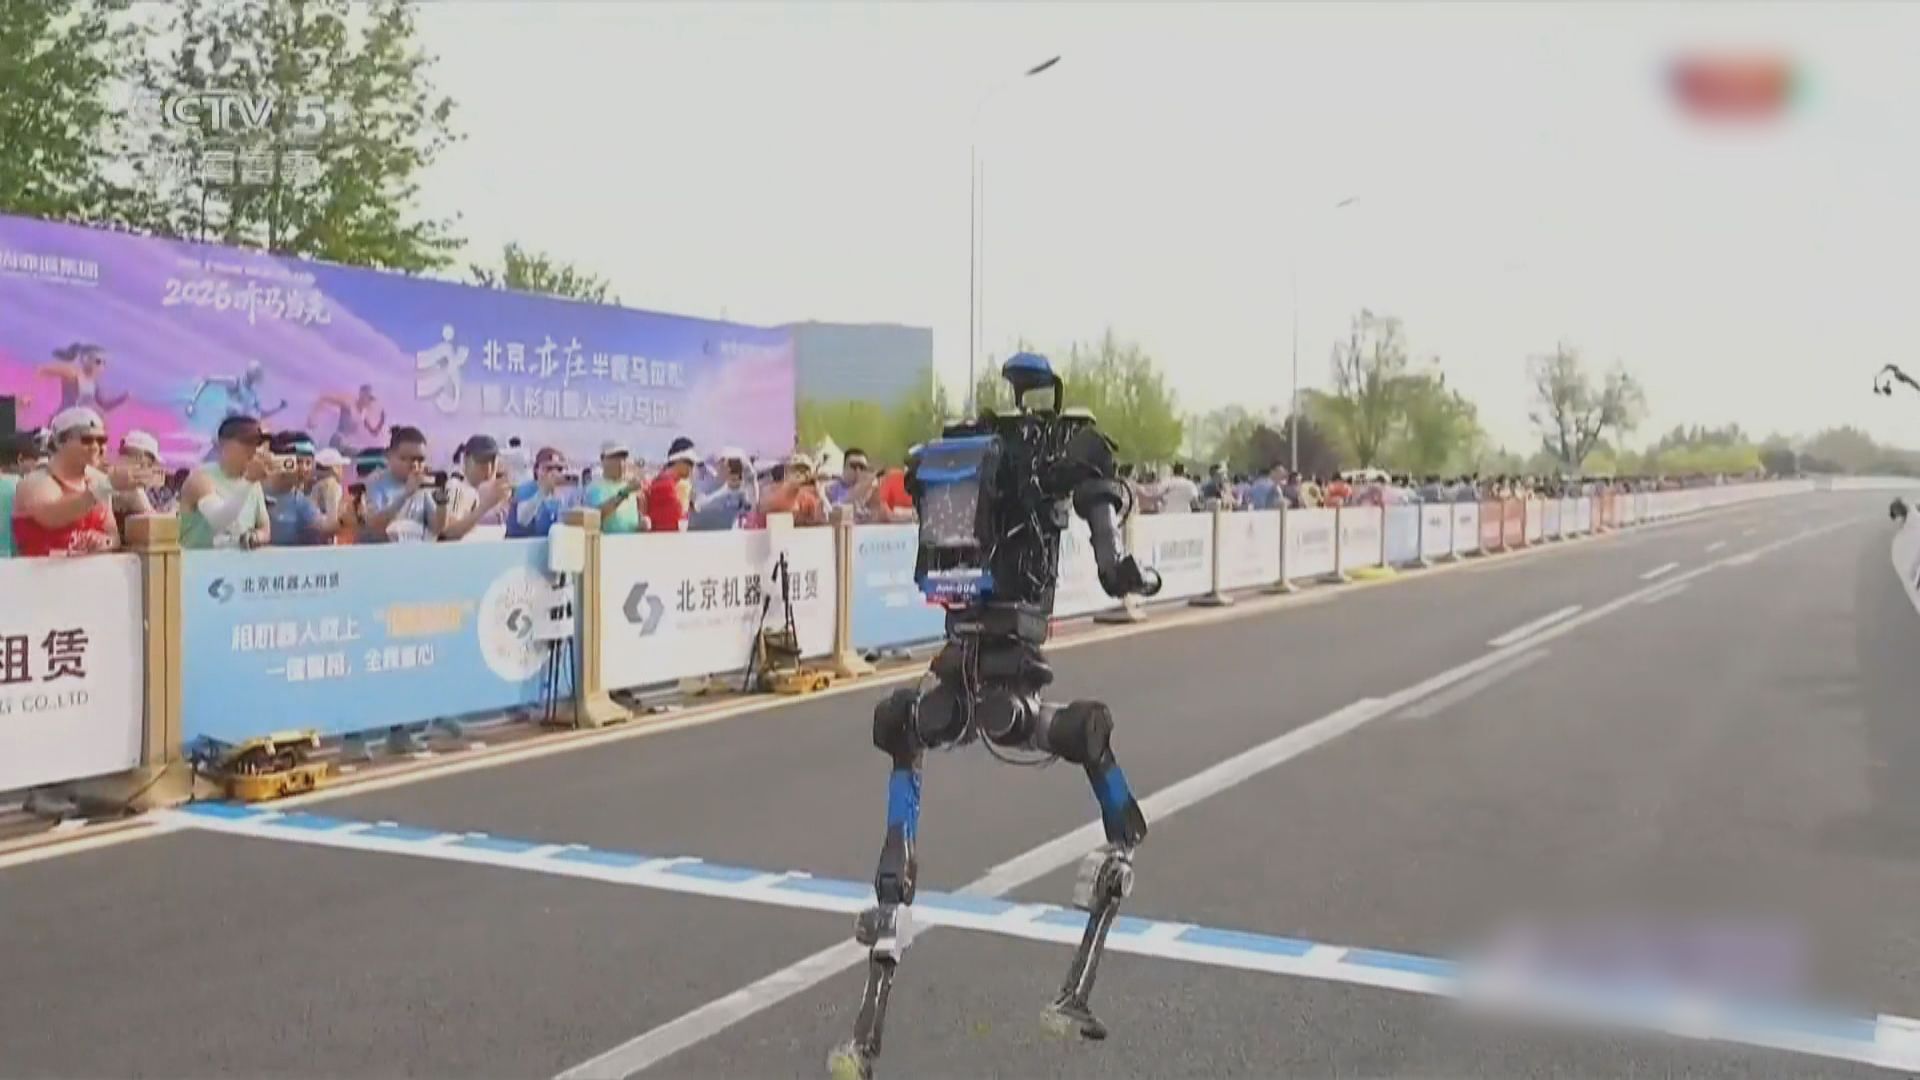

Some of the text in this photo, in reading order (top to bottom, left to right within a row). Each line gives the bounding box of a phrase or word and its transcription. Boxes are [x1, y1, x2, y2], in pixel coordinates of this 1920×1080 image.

[483, 385, 681, 425] 人形机人半程马拉
[676, 570, 819, 613] 北京机器租赁
[0, 628, 89, 684] 租赁
